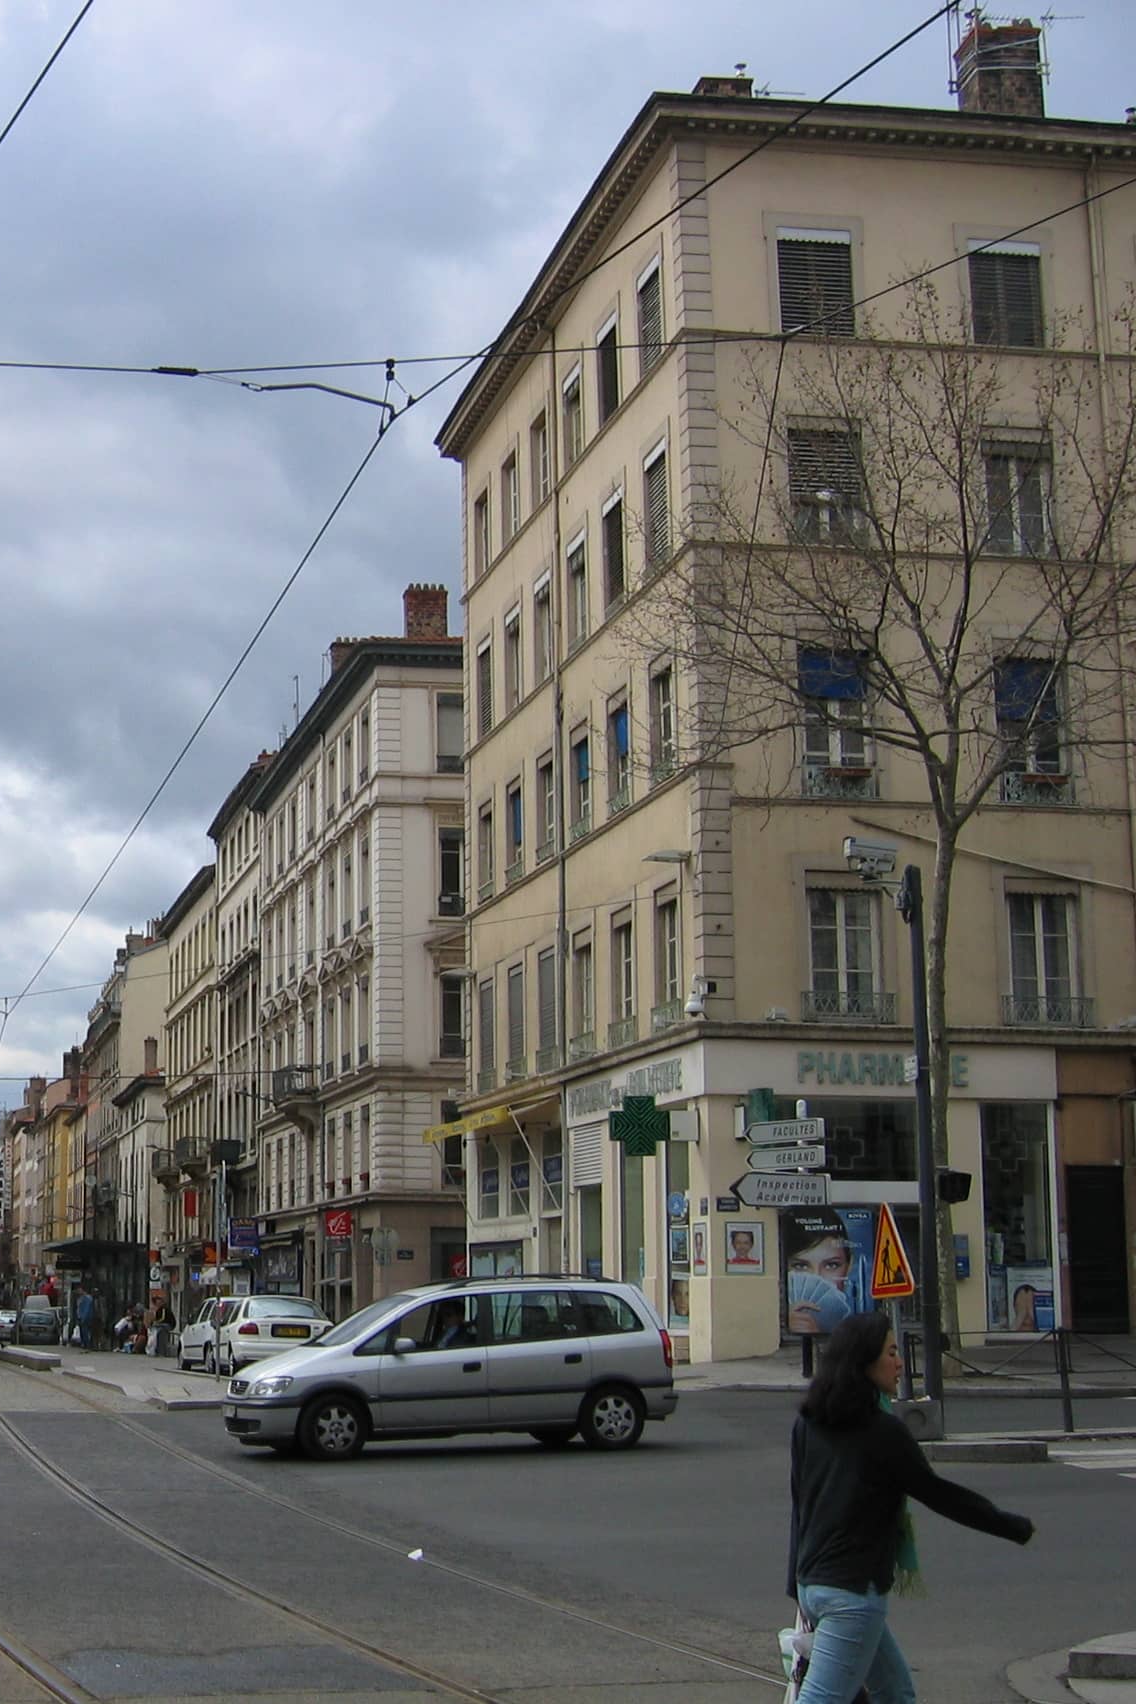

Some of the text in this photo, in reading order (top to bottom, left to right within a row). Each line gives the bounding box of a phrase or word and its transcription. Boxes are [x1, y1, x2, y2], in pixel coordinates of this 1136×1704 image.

[797, 1051, 969, 1088] PHARME
[775, 1151, 816, 1164] GERLAND
[756, 1179, 817, 1193] Inspection
